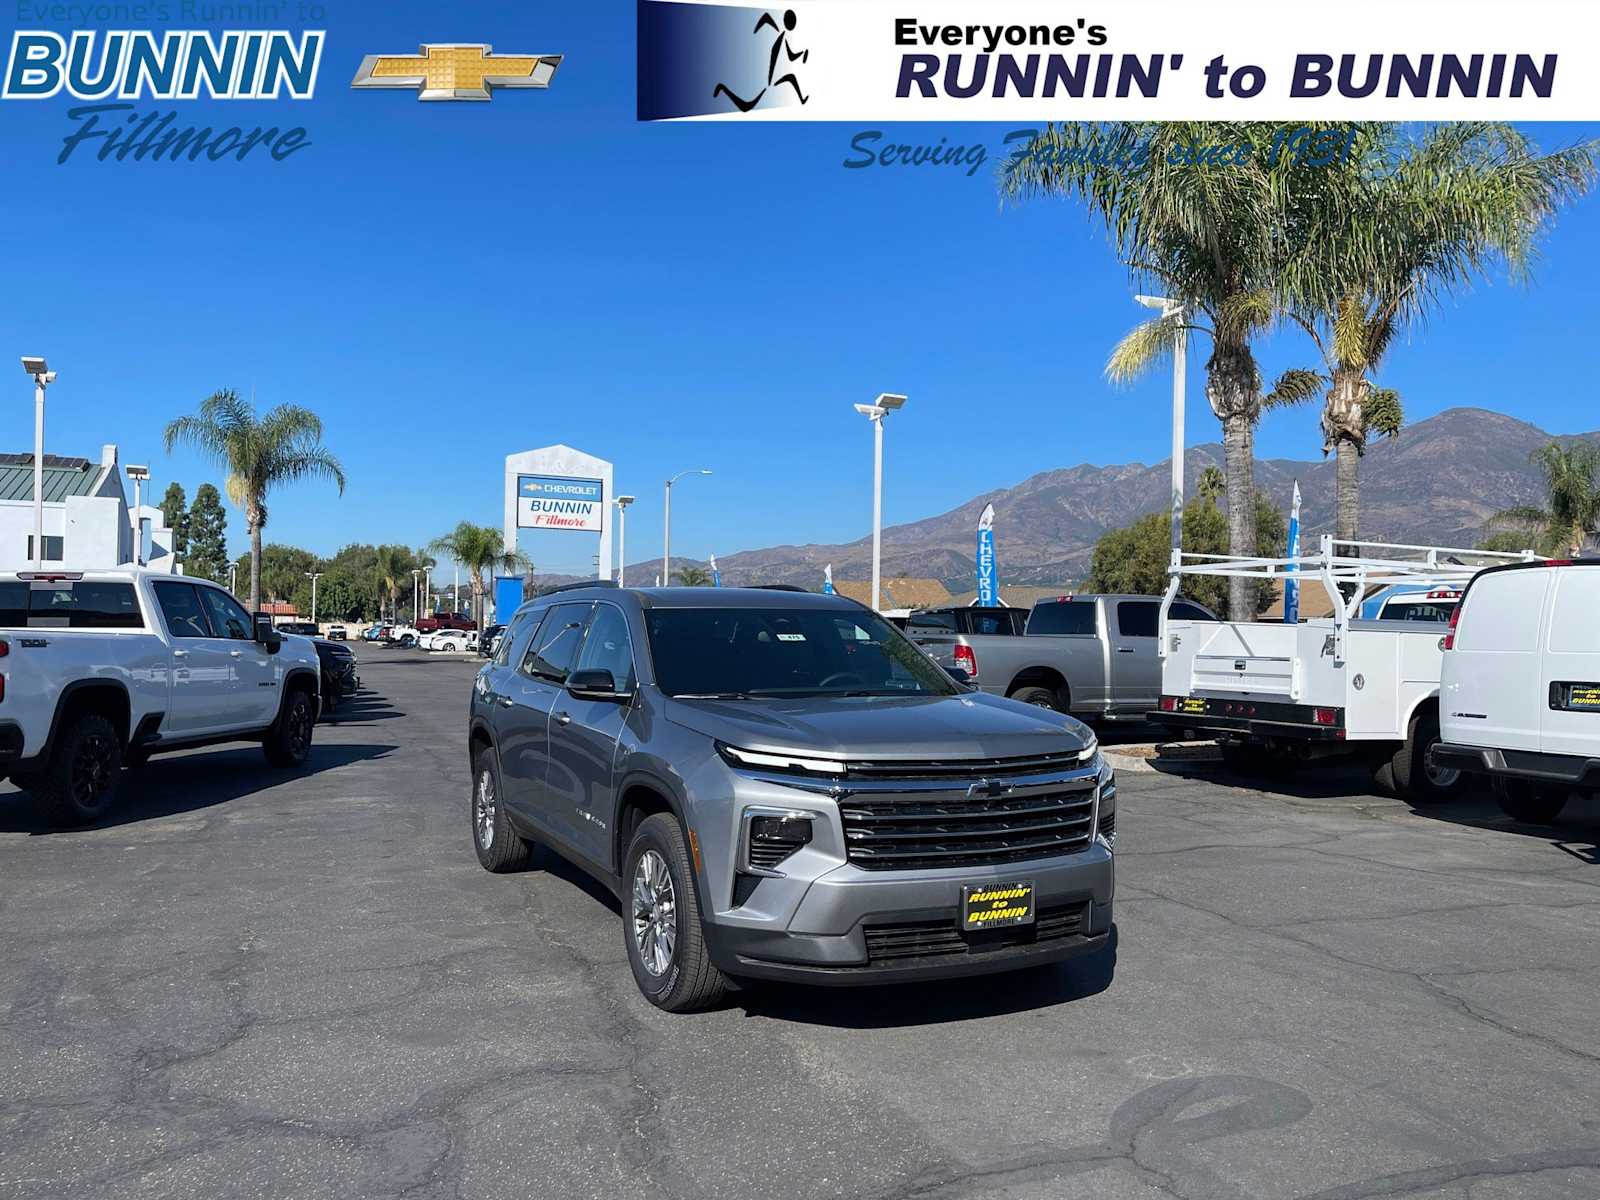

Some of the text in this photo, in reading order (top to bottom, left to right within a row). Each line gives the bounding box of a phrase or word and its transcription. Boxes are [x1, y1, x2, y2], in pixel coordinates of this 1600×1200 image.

[544, 484, 597, 496] CHEVROLET
[530, 500, 593, 515] BUNNIN
[534, 514, 587, 528] Fillmore
[969, 888, 1032, 903] RUNNIN'
[991, 901, 1009, 909] to
[968, 907, 1028, 923] BUNNIN
